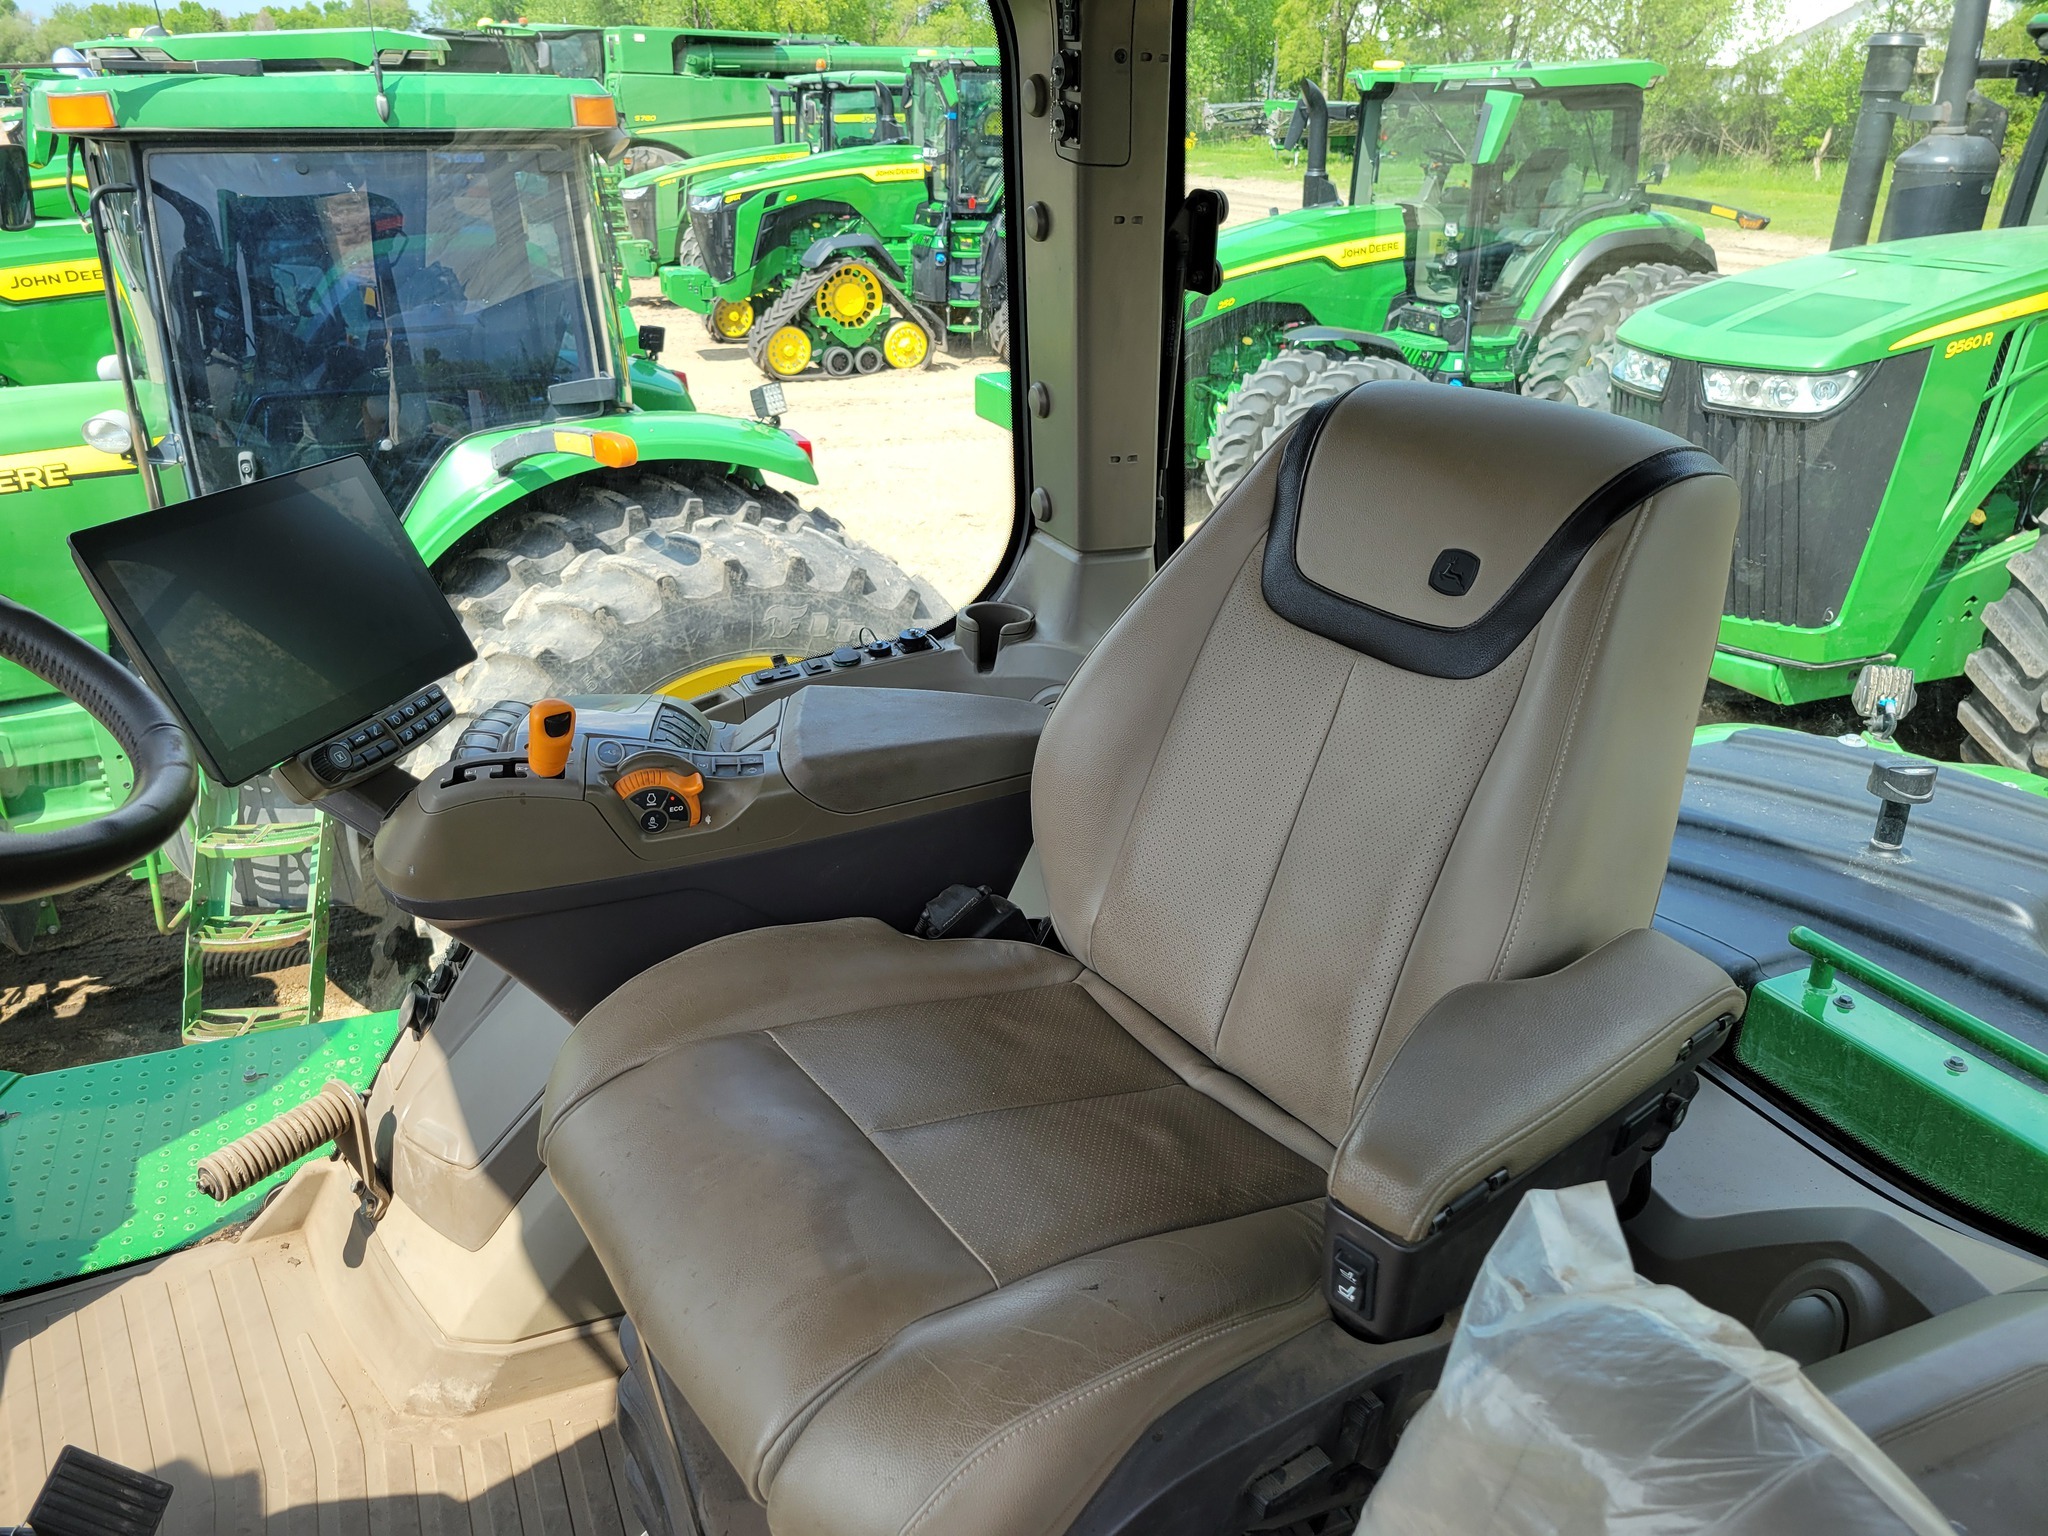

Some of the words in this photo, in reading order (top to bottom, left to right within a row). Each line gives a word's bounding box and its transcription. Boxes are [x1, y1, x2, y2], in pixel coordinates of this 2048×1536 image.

[1341, 247, 1367, 259] JOHN
[1368, 241, 1399, 254] DEERE
[10, 273, 62, 289] JOHN
[1944, 334, 1982, 359] 9560
[1982, 331, 1994, 347] R
[0, 462, 73, 495] ERE
[669, 804, 684, 813] ECO
